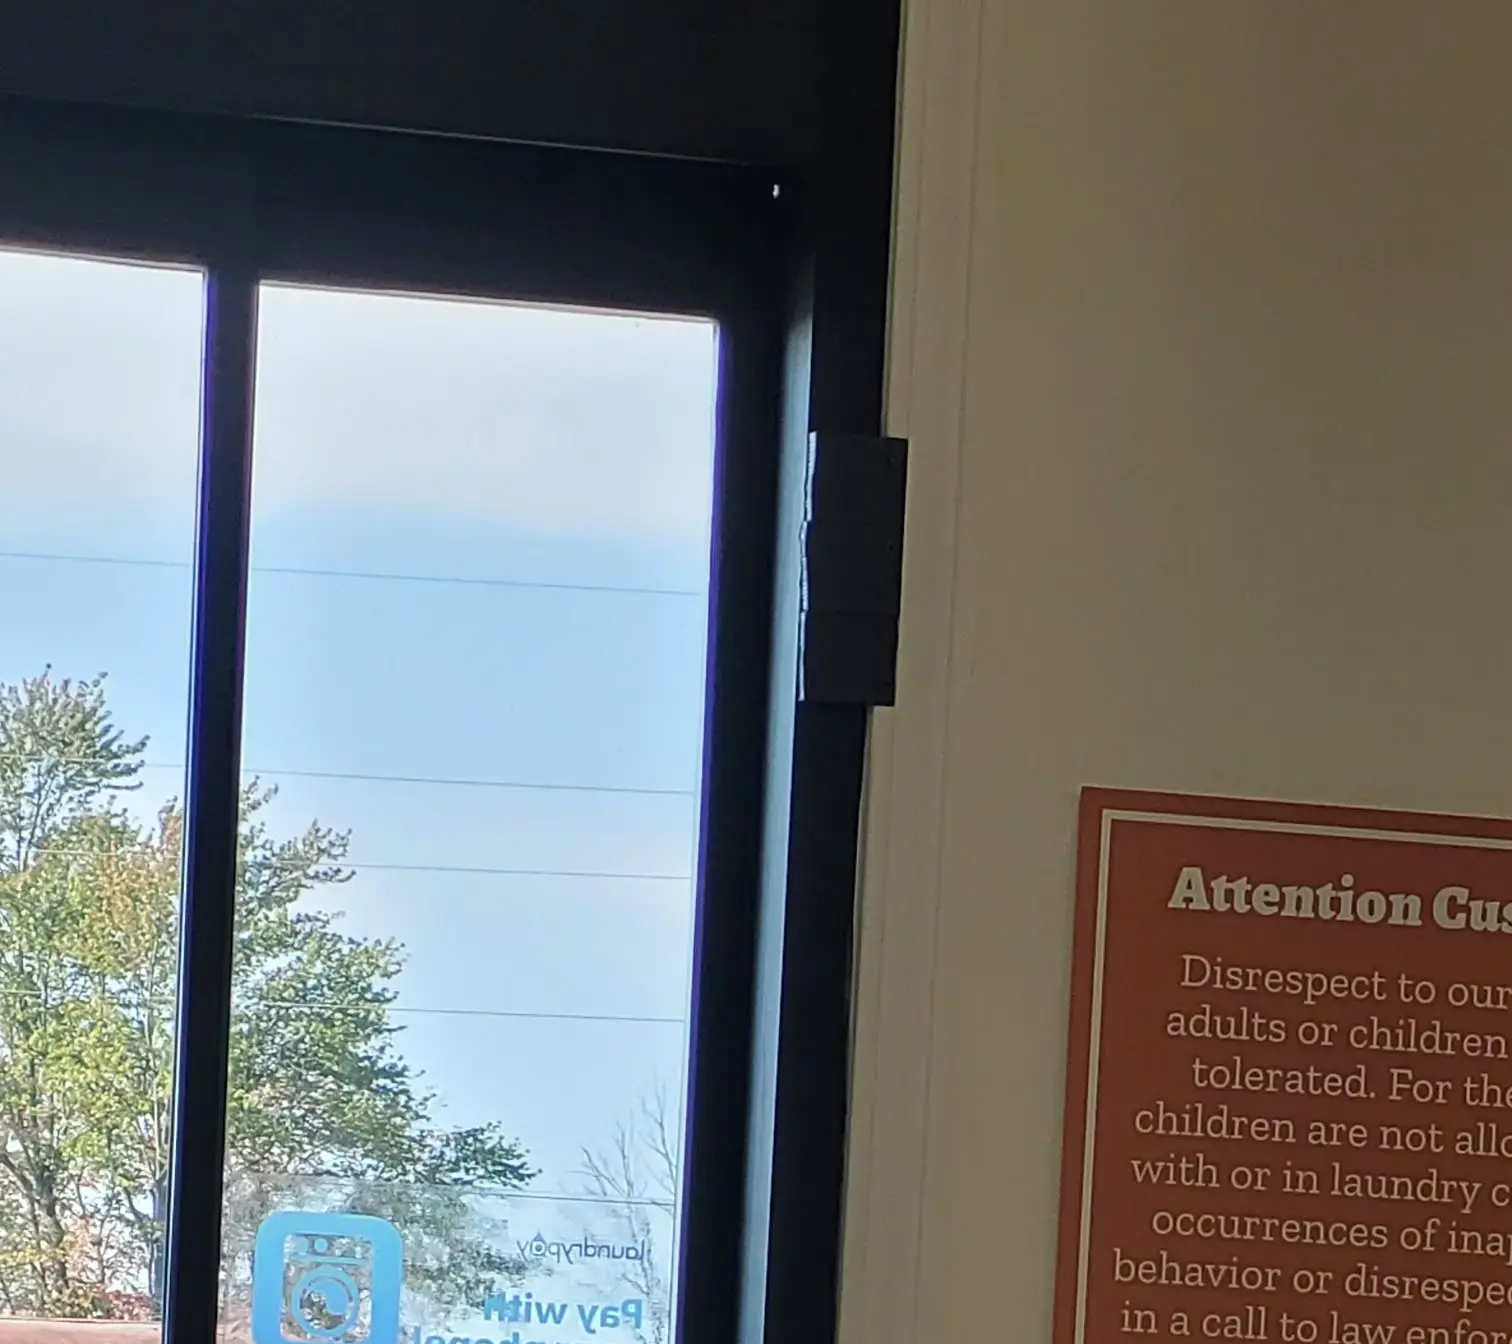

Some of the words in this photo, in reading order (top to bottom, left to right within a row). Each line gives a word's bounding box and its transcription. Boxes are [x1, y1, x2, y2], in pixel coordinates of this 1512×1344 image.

[1168, 867, 1422, 925] Attention
[1181, 955, 1386, 1004] Disrespect
[1399, 974, 1435, 1003] to
[1448, 984, 1512, 1009] our
[1167, 1004, 1285, 1042] adults
[1299, 1023, 1337, 1045] or
[1350, 1016, 1508, 1058] children
[1193, 1056, 1375, 1098] tolerated.
[1389, 1069, 1451, 1103] For
[1136, 1101, 1296, 1142] children
[1308, 1122, 1367, 1147] are
[1379, 1124, 1443, 1152] not
[1131, 1153, 1220, 1187] with
[1231, 1167, 1271, 1190] or
[1283, 1161, 1320, 1193] in
[1331, 1162, 1481, 1213] laundry
[1153, 1212, 1387, 1247] occurrences
[1401, 1218, 1440, 1251] of
[1114, 1248, 1281, 1290] behavior
[1294, 1270, 1332, 1293] or
[1121, 1300, 1158, 1333] in
[1170, 1313, 1190, 1335] a
[1203, 1306, 1267, 1339] call
[1280, 1313, 1317, 1342] to
